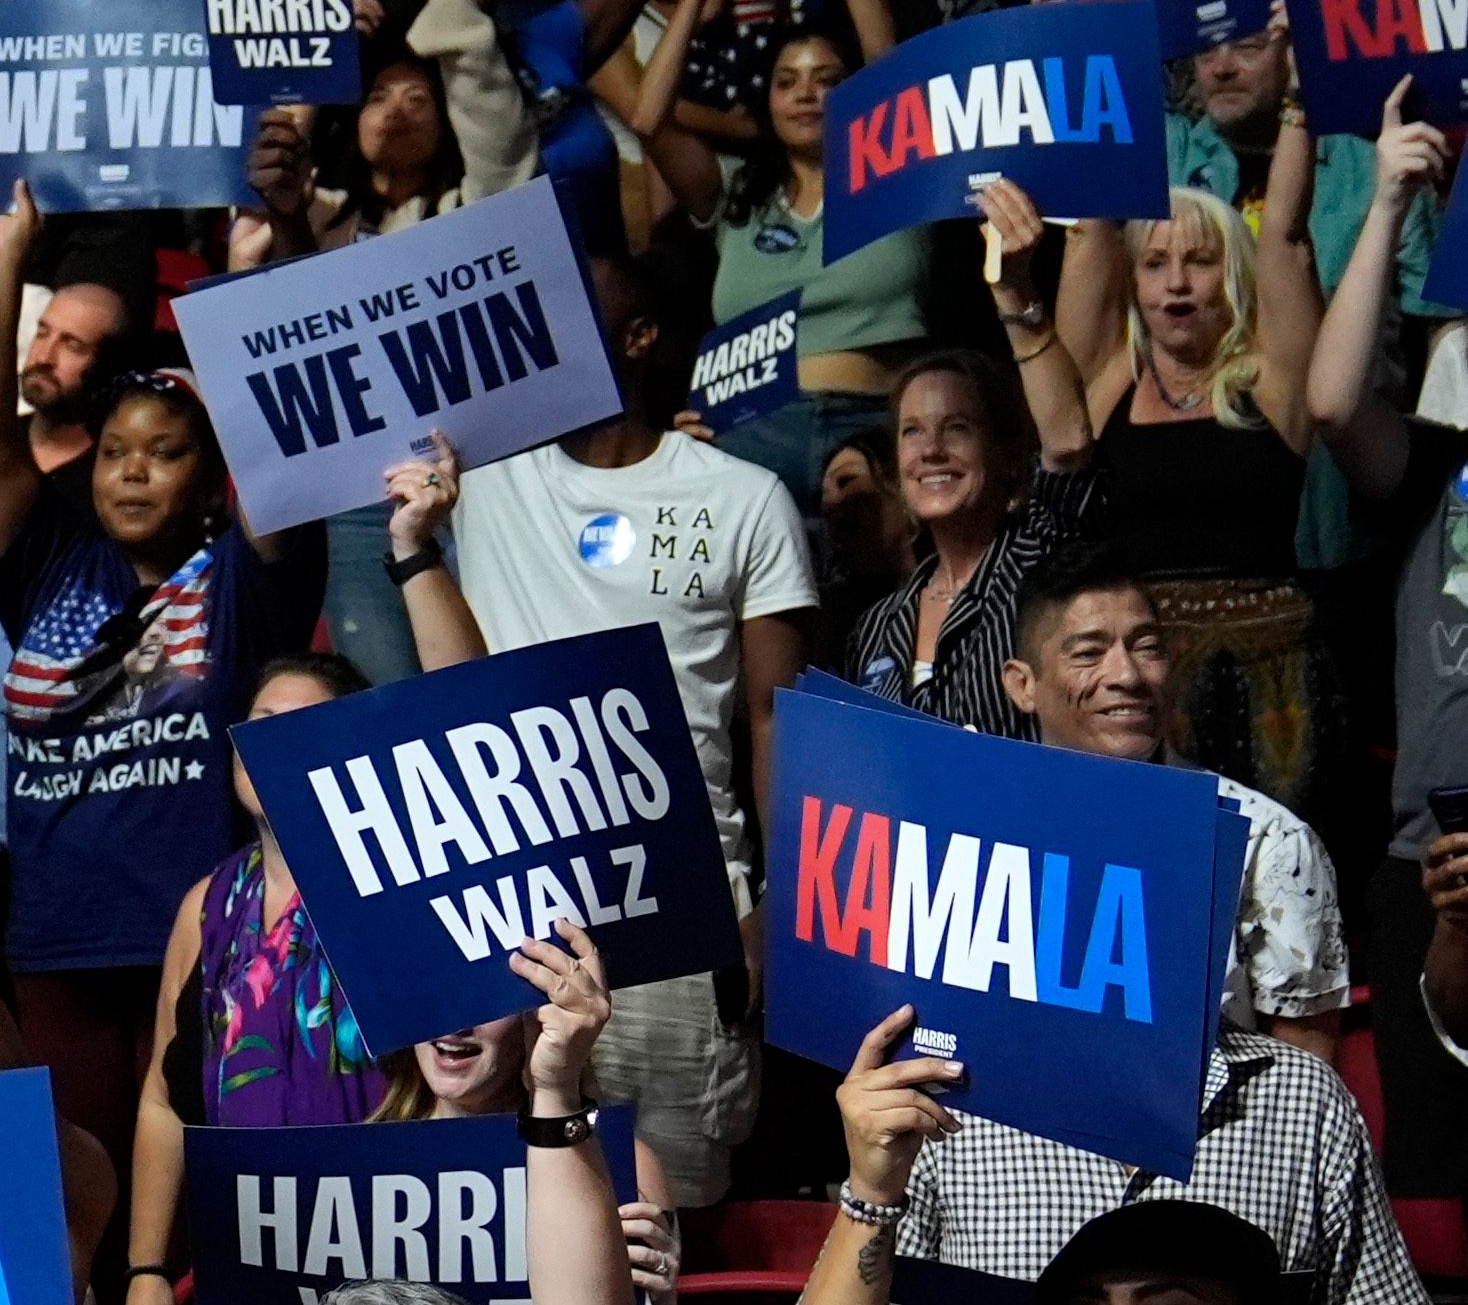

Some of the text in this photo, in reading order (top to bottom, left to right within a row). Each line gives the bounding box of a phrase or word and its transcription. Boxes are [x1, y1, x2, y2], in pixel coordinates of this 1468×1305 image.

[93, 32, 143, 58] WE
[235, 38, 333, 69] WALZ
[846, 54, 1134, 194] KAMALA
[242, 246, 523, 360] WHEN WE VOTE
[247, 279, 561, 459] WE WIN
[691, 306, 797, 394] HARRIS
[705, 358, 779, 407] WALZ
[72, 711, 210, 763] AMERICA
[89, 758, 181, 794] AGAIN
[306, 686, 671, 898] HARRIS
[430, 843, 659, 964] WALZ
[794, 795, 1154, 1024] KAMALA
[912, 1026, 957, 1052] HARRIS
